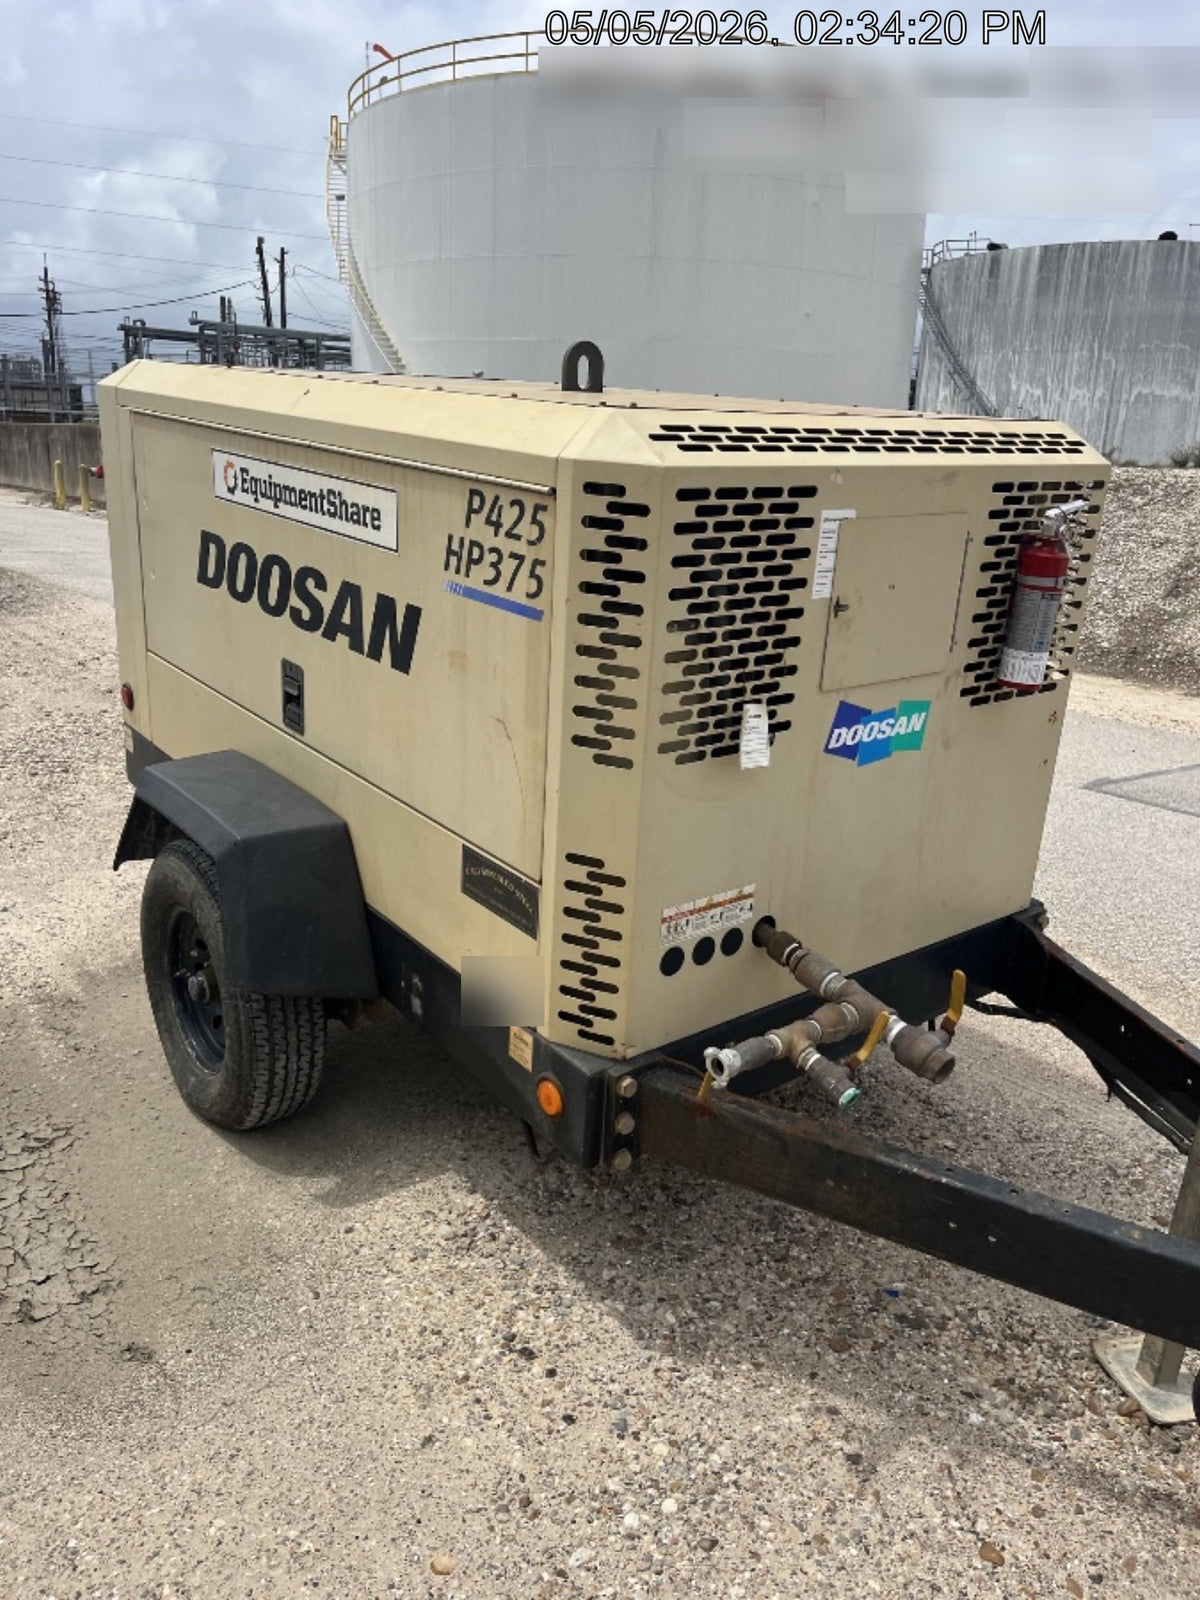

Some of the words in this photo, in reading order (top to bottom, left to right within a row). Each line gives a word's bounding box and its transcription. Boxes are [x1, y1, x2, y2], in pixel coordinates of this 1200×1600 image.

[240, 467, 381, 531] EquipmentShare
[465, 488, 549, 546] P425
[444, 533, 547, 599] HP375
[197, 530, 422, 675] DOOSAN
[828, 712, 927, 750] DOOSAN
